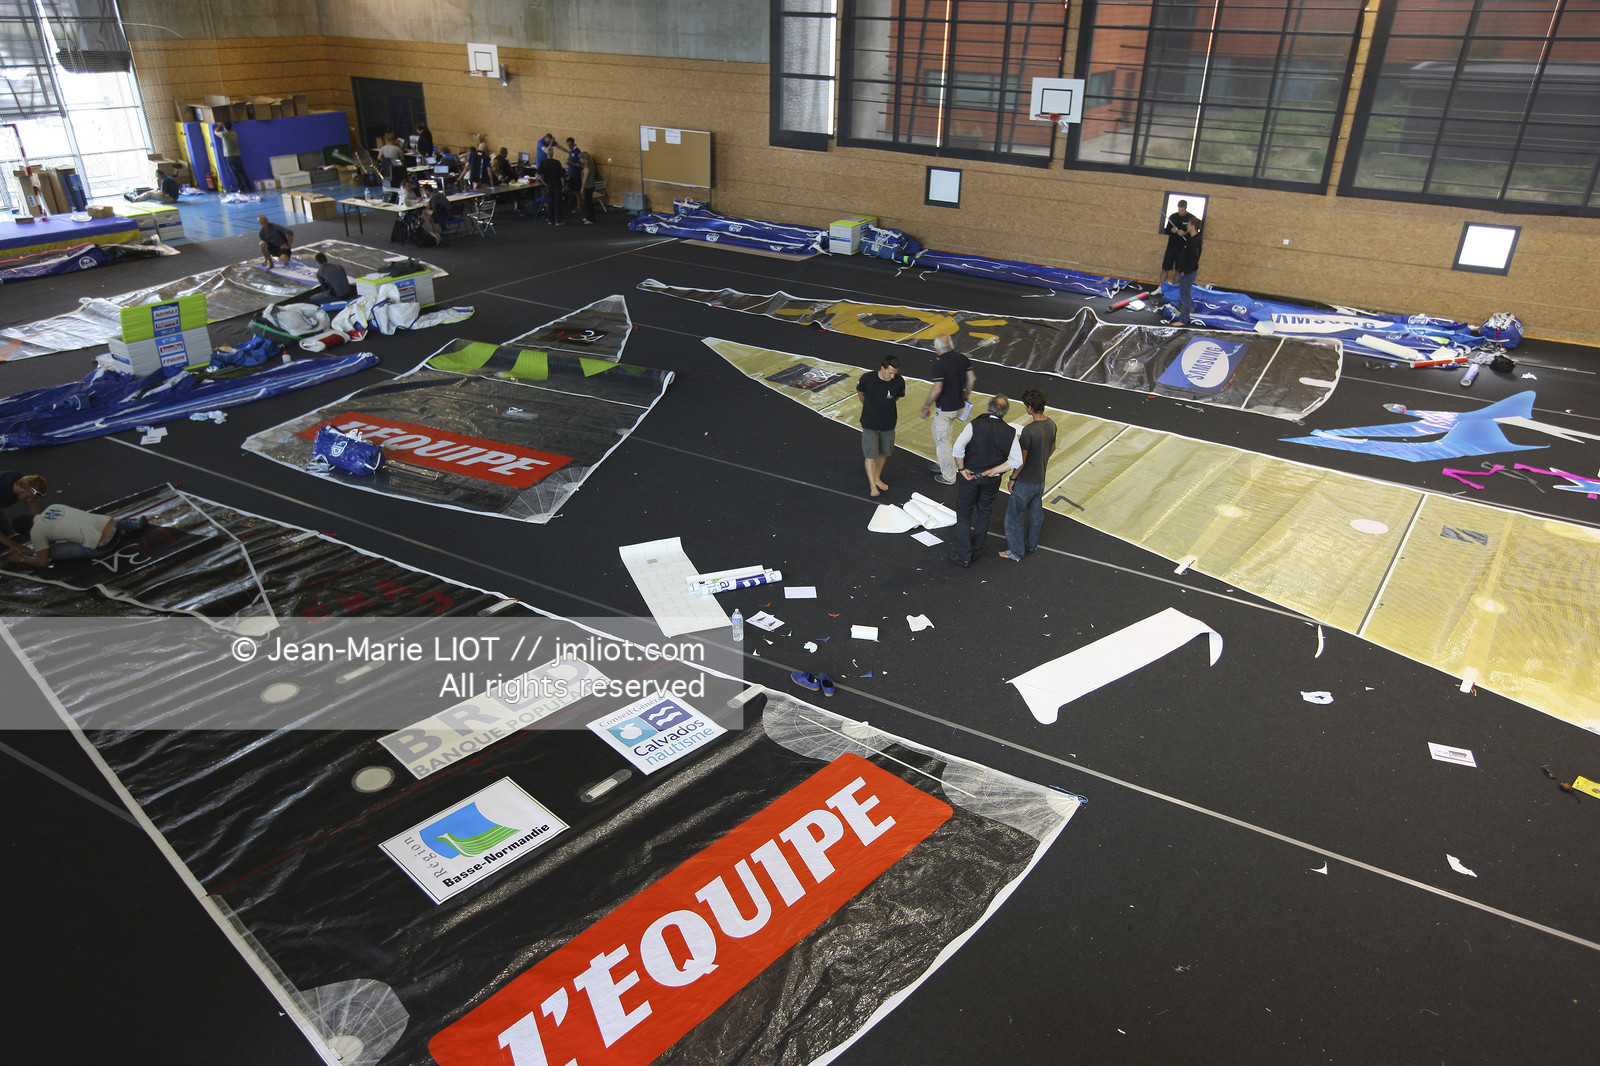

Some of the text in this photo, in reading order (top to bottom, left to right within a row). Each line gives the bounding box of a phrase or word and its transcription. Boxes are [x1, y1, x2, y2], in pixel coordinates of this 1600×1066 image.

[1185, 346, 1225, 380] SAMSUNG
[382, 658, 590, 765] BRED
[598, 709, 634, 728] Conseil
[411, 725, 506, 777] BANQUE
[633, 719, 705, 756] Calvados
[645, 727, 715, 766] nautisme
[404, 836, 448, 879] Région
[442, 823, 550, 888] Basse-Normandie
